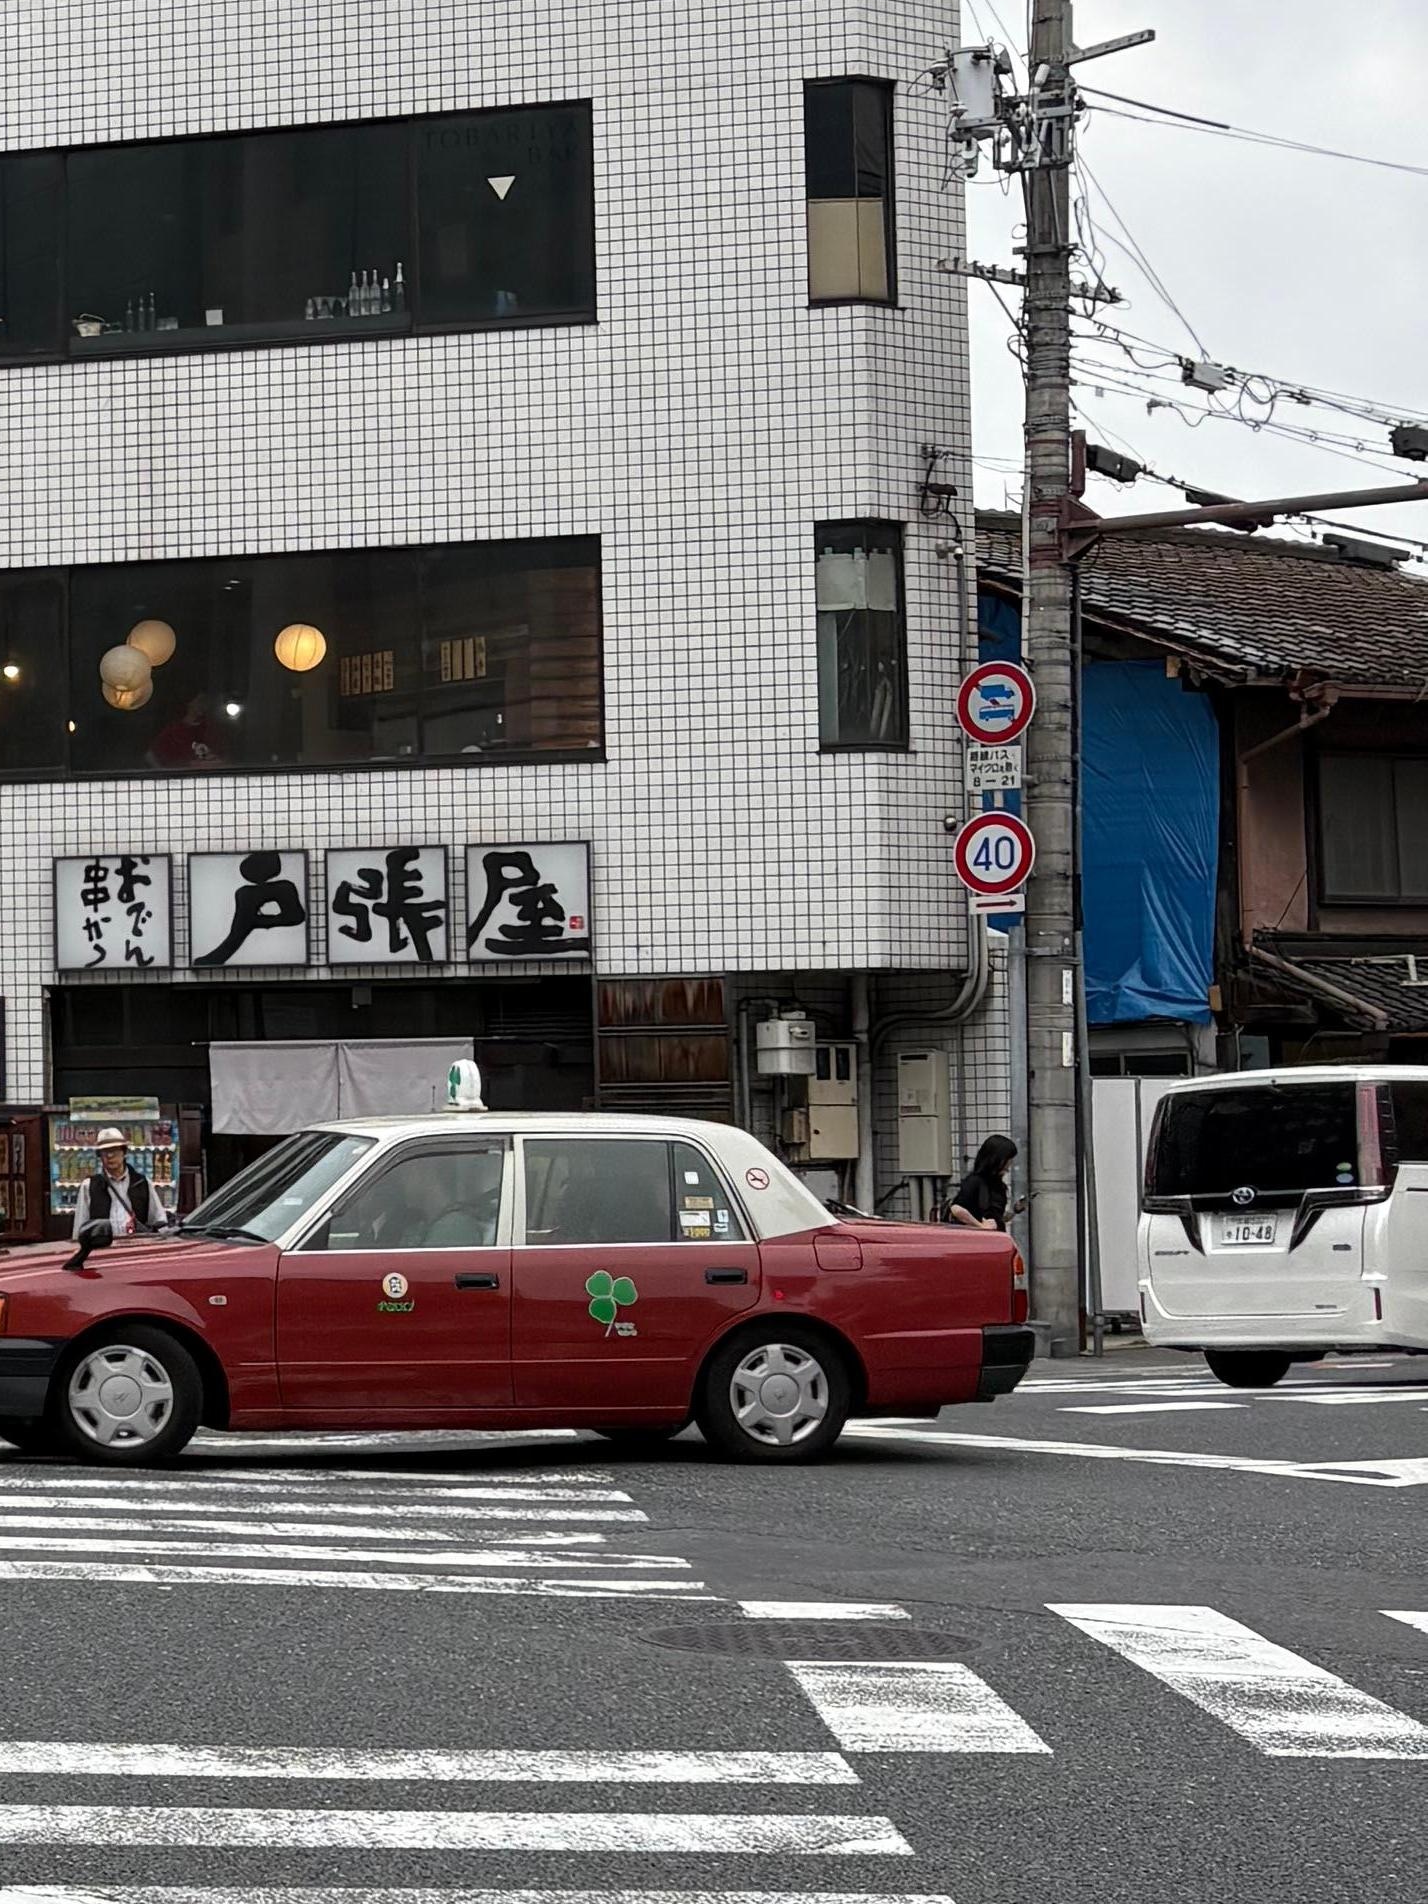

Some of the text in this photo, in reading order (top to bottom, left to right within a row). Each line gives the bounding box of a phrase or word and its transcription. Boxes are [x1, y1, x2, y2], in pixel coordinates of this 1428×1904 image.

[1001, 775, 1015, 786] 21
[973, 835, 1015, 872] 40
[80, 857, 111, 968] 串かつ
[114, 856, 155, 967] おでん
[1235, 1226, 1272, 1241] 10-48
